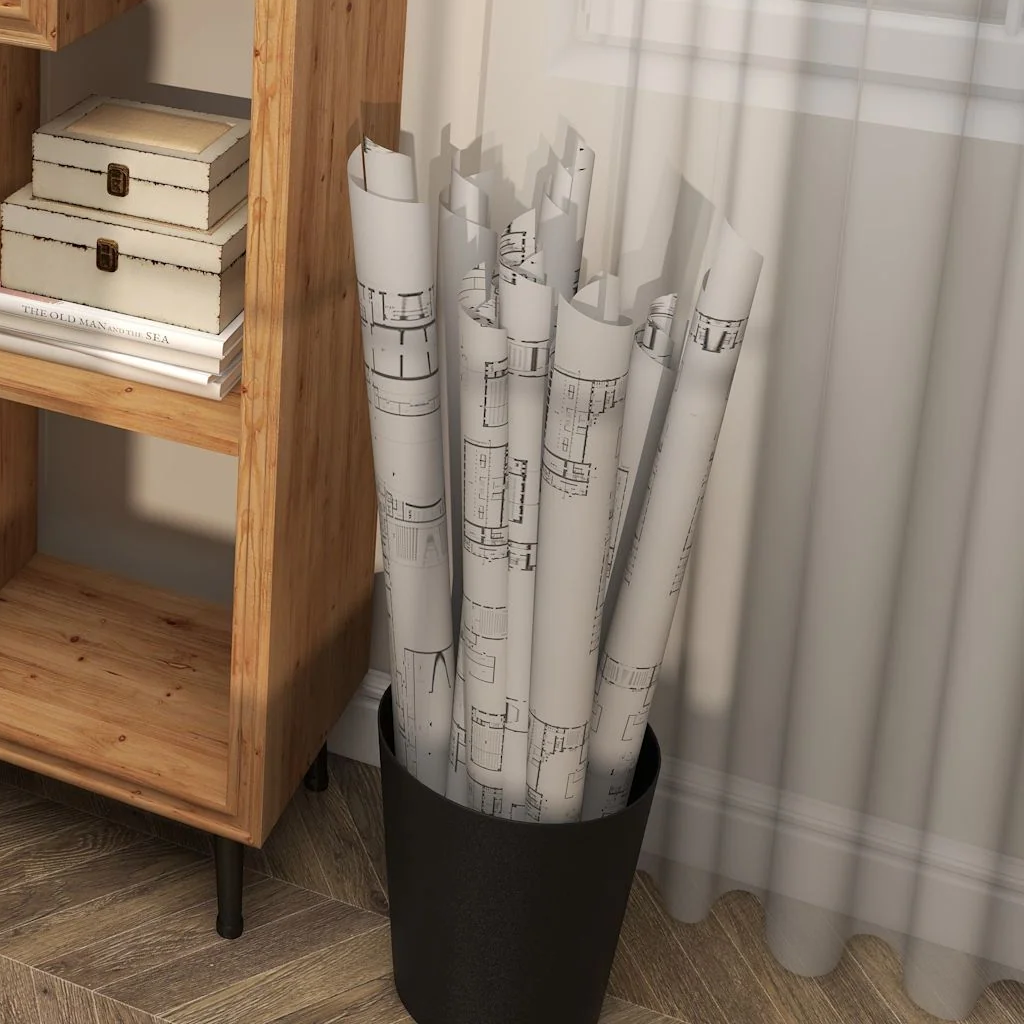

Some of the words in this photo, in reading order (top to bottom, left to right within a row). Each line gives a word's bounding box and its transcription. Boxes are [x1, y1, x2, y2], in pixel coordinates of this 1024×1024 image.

[22, 304, 47, 317] THE
[49, 311, 76, 323] OLD
[79, 317, 107, 330] MAN
[145, 331, 170, 344] SEA
